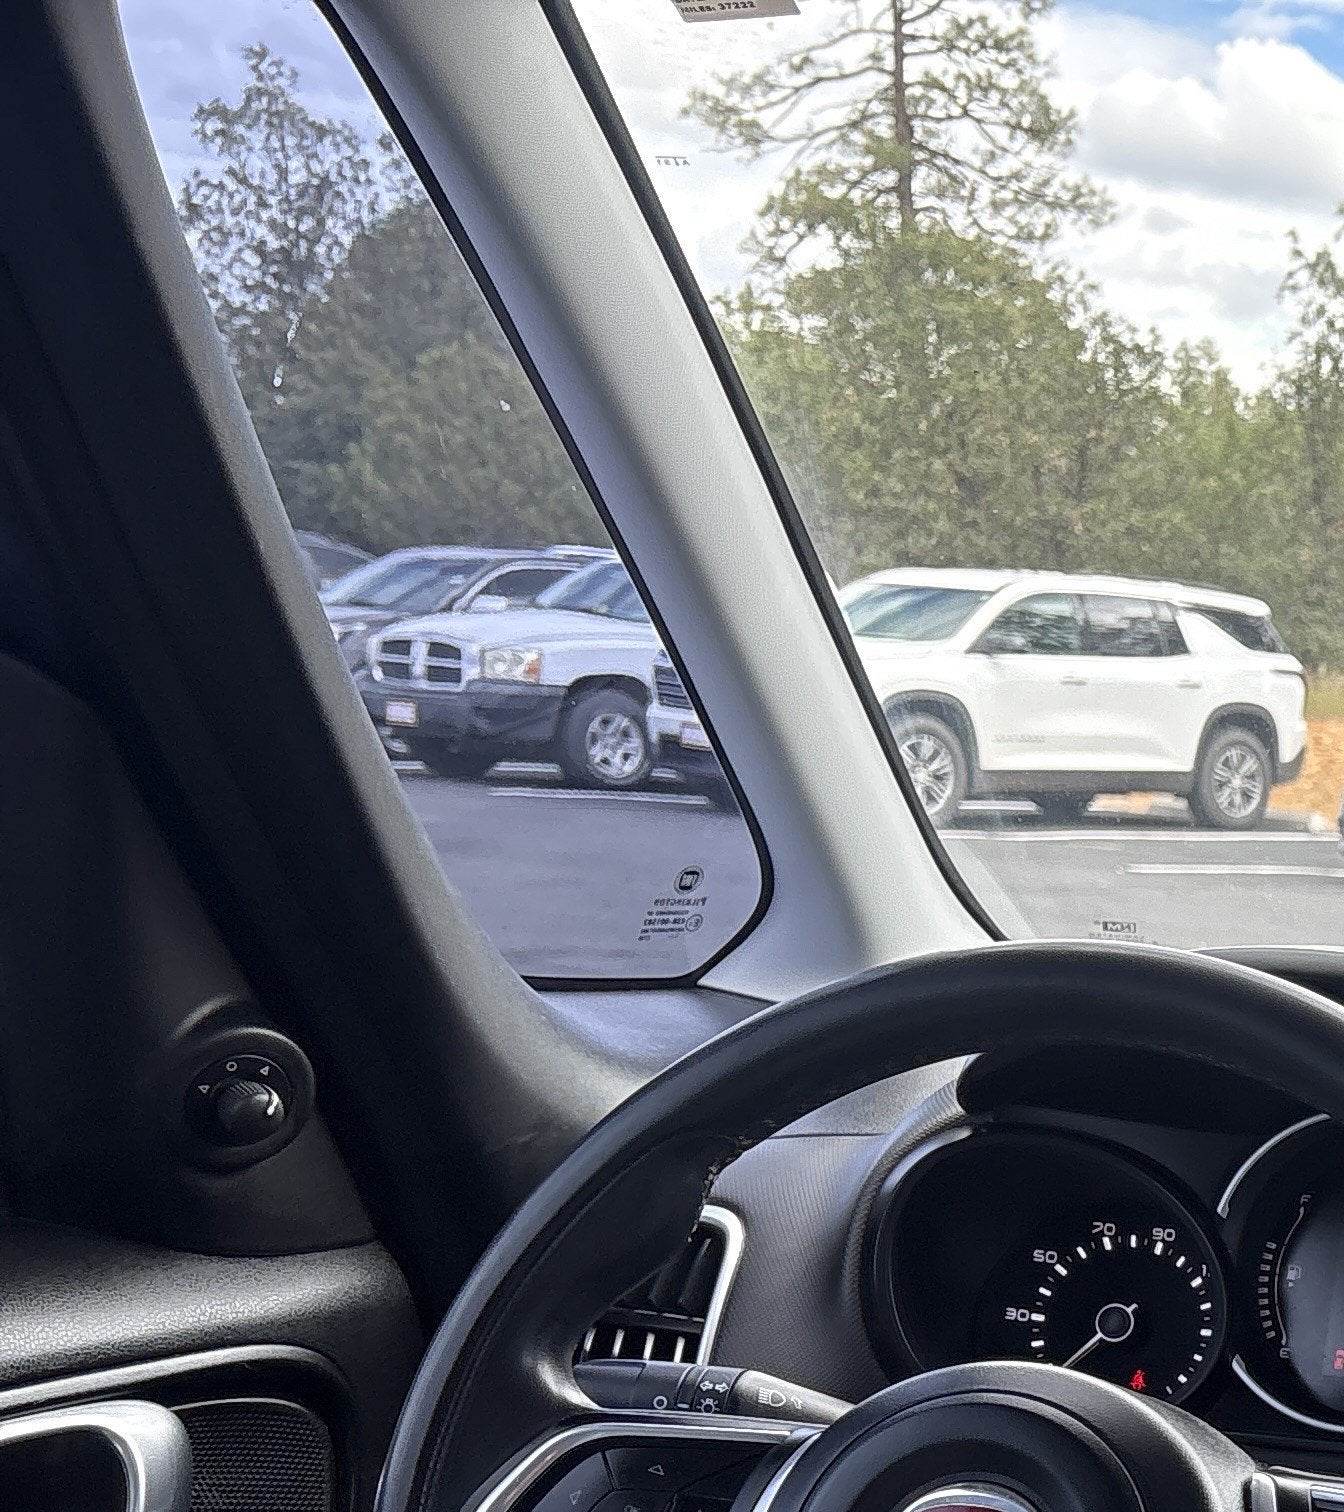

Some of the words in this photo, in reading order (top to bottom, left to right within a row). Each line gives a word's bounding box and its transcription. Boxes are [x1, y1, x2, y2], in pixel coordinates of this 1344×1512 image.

[718, 1, 757, 11] 37222
[1091, 1221, 1116, 1237] 70
[1152, 1227, 1176, 1242] 90
[1032, 1249, 1058, 1264] 50
[1004, 1306, 1030, 1322] 30
[1279, 1347, 1291, 1359] E
